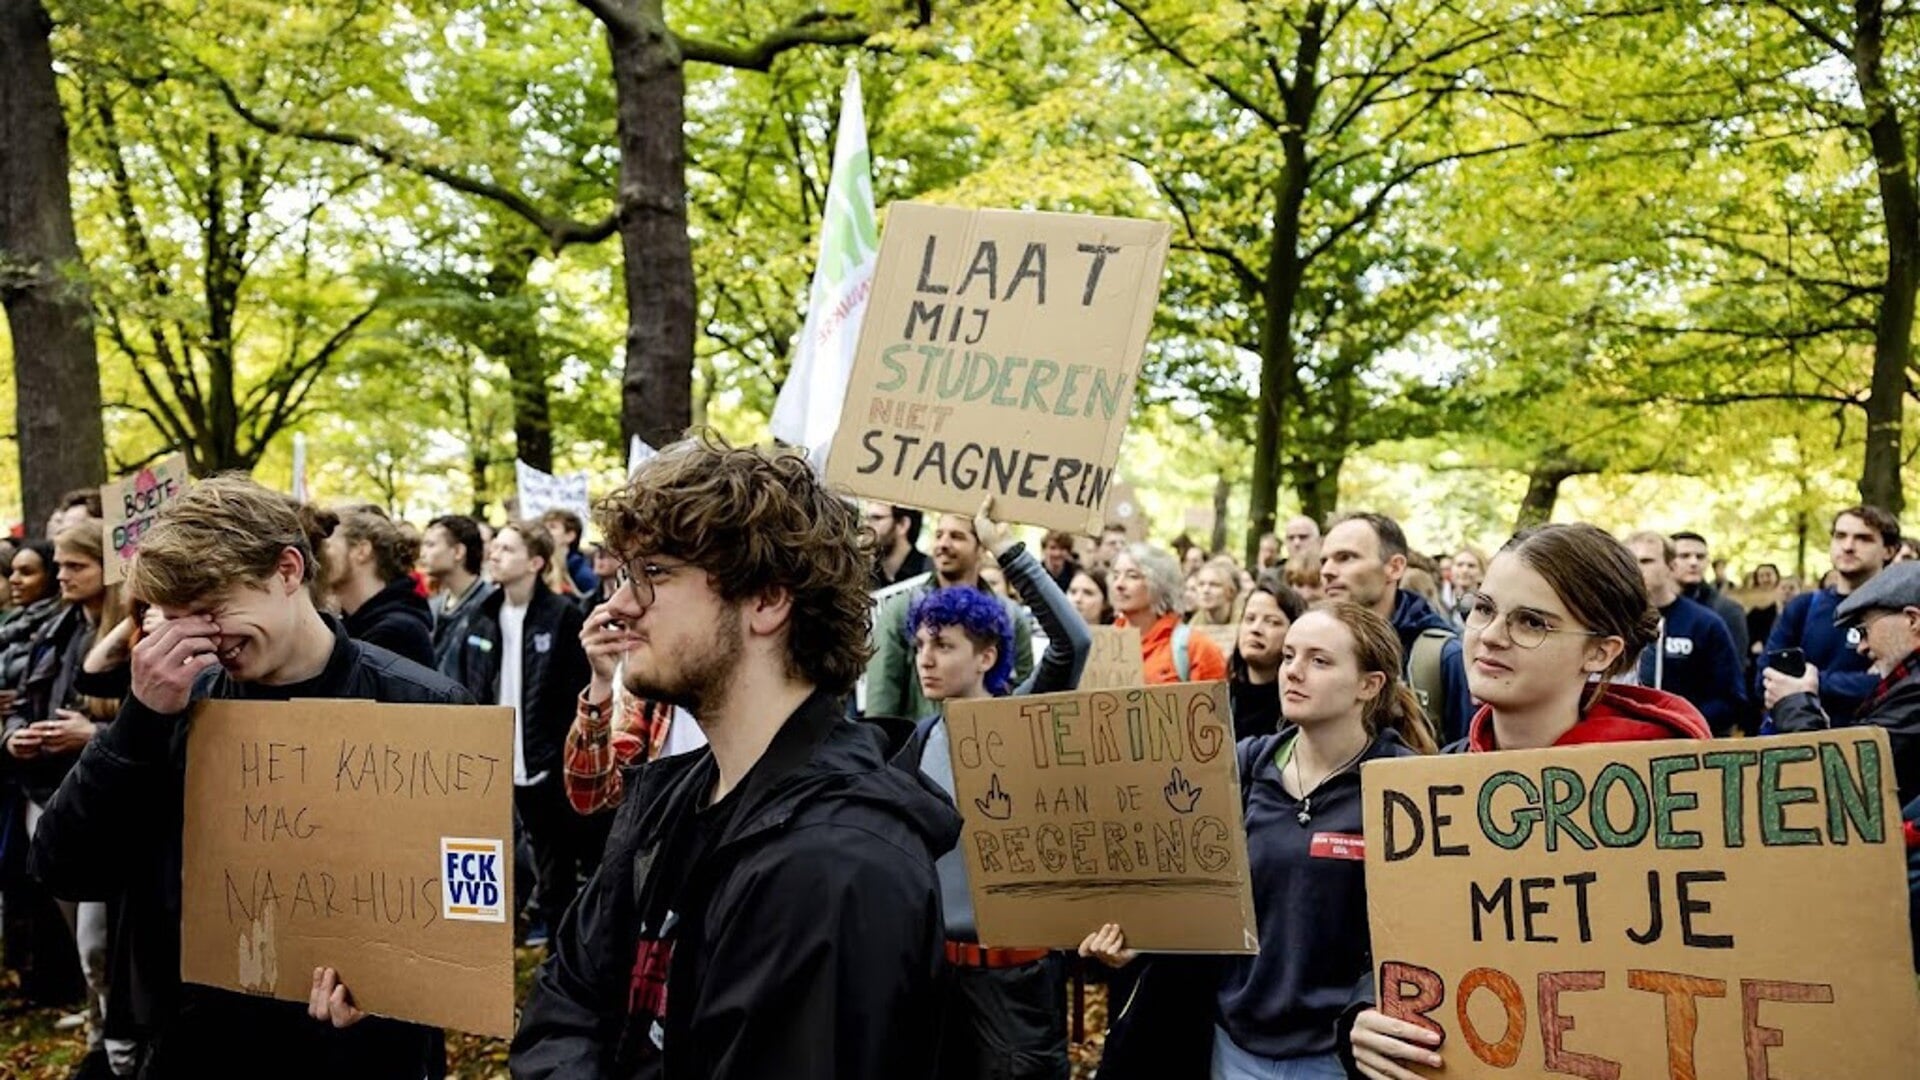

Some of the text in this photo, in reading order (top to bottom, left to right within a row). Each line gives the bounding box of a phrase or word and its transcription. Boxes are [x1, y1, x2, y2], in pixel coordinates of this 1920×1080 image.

[916, 234, 1120, 306] LAAT
[904, 300, 989, 344] MIJ
[876, 343, 1128, 421] STUDEREN
[868, 398, 955, 433] NIET
[856, 430, 1116, 512] STAGNEREN
[241, 738, 500, 798] HET KABINET
[959, 713, 1007, 770] de
[242, 804, 323, 842] MAG
[1034, 784, 1145, 814] AAN DE
[1382, 739, 1886, 862] DE GROETEN
[447, 853, 497, 881] FCK
[448, 881, 499, 907] VVD
[1469, 870, 1735, 949] MET JE
